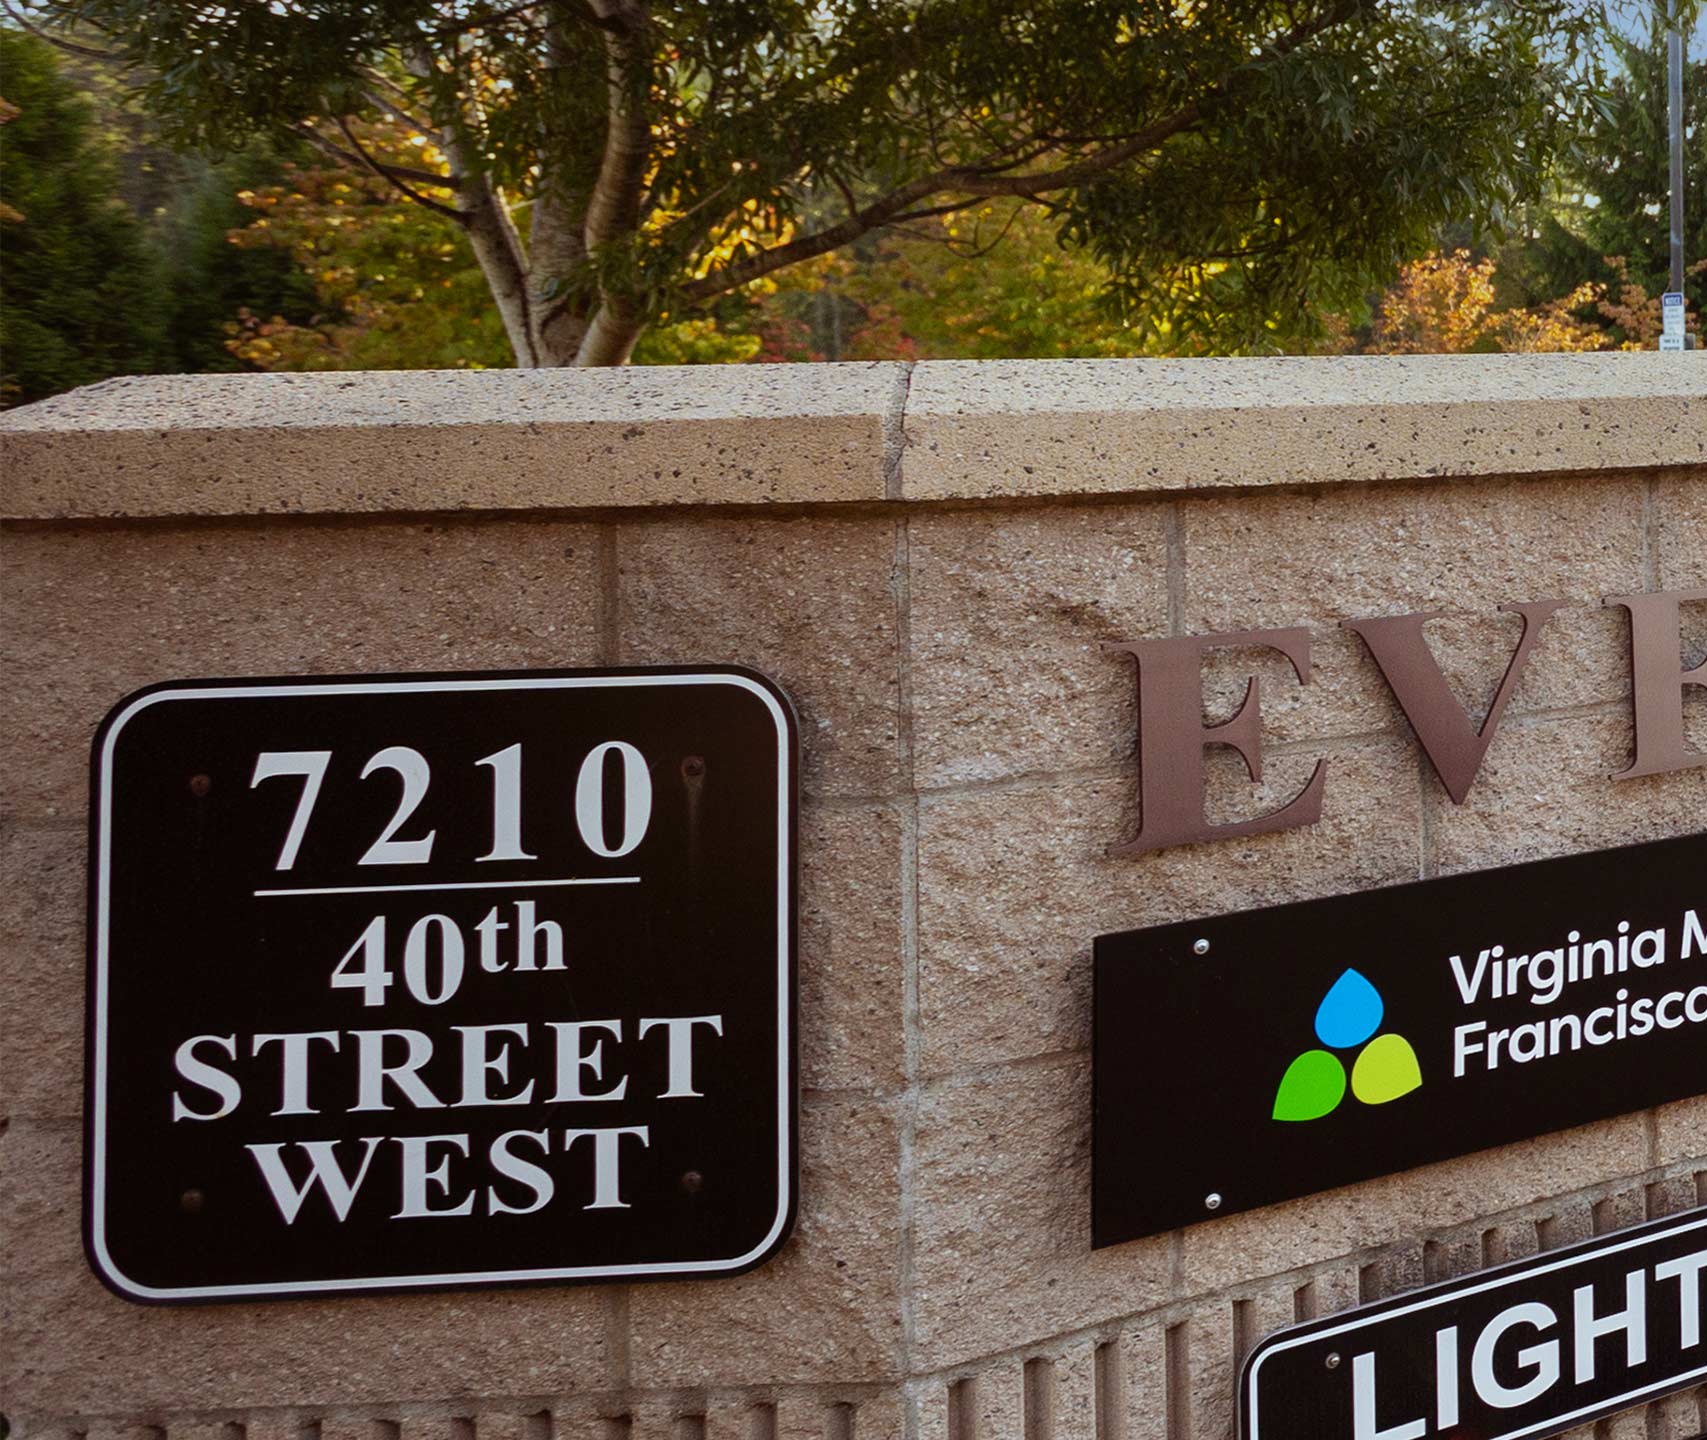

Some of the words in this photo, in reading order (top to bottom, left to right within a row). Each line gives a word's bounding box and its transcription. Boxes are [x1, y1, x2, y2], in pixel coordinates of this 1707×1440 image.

[250, 740, 652, 871] 7210
[331, 900, 568, 1007] 40th
[1448, 920, 1666, 1005] Virginia
[173, 1014, 723, 1122] STREET
[244, 1125, 650, 1225] WEST
